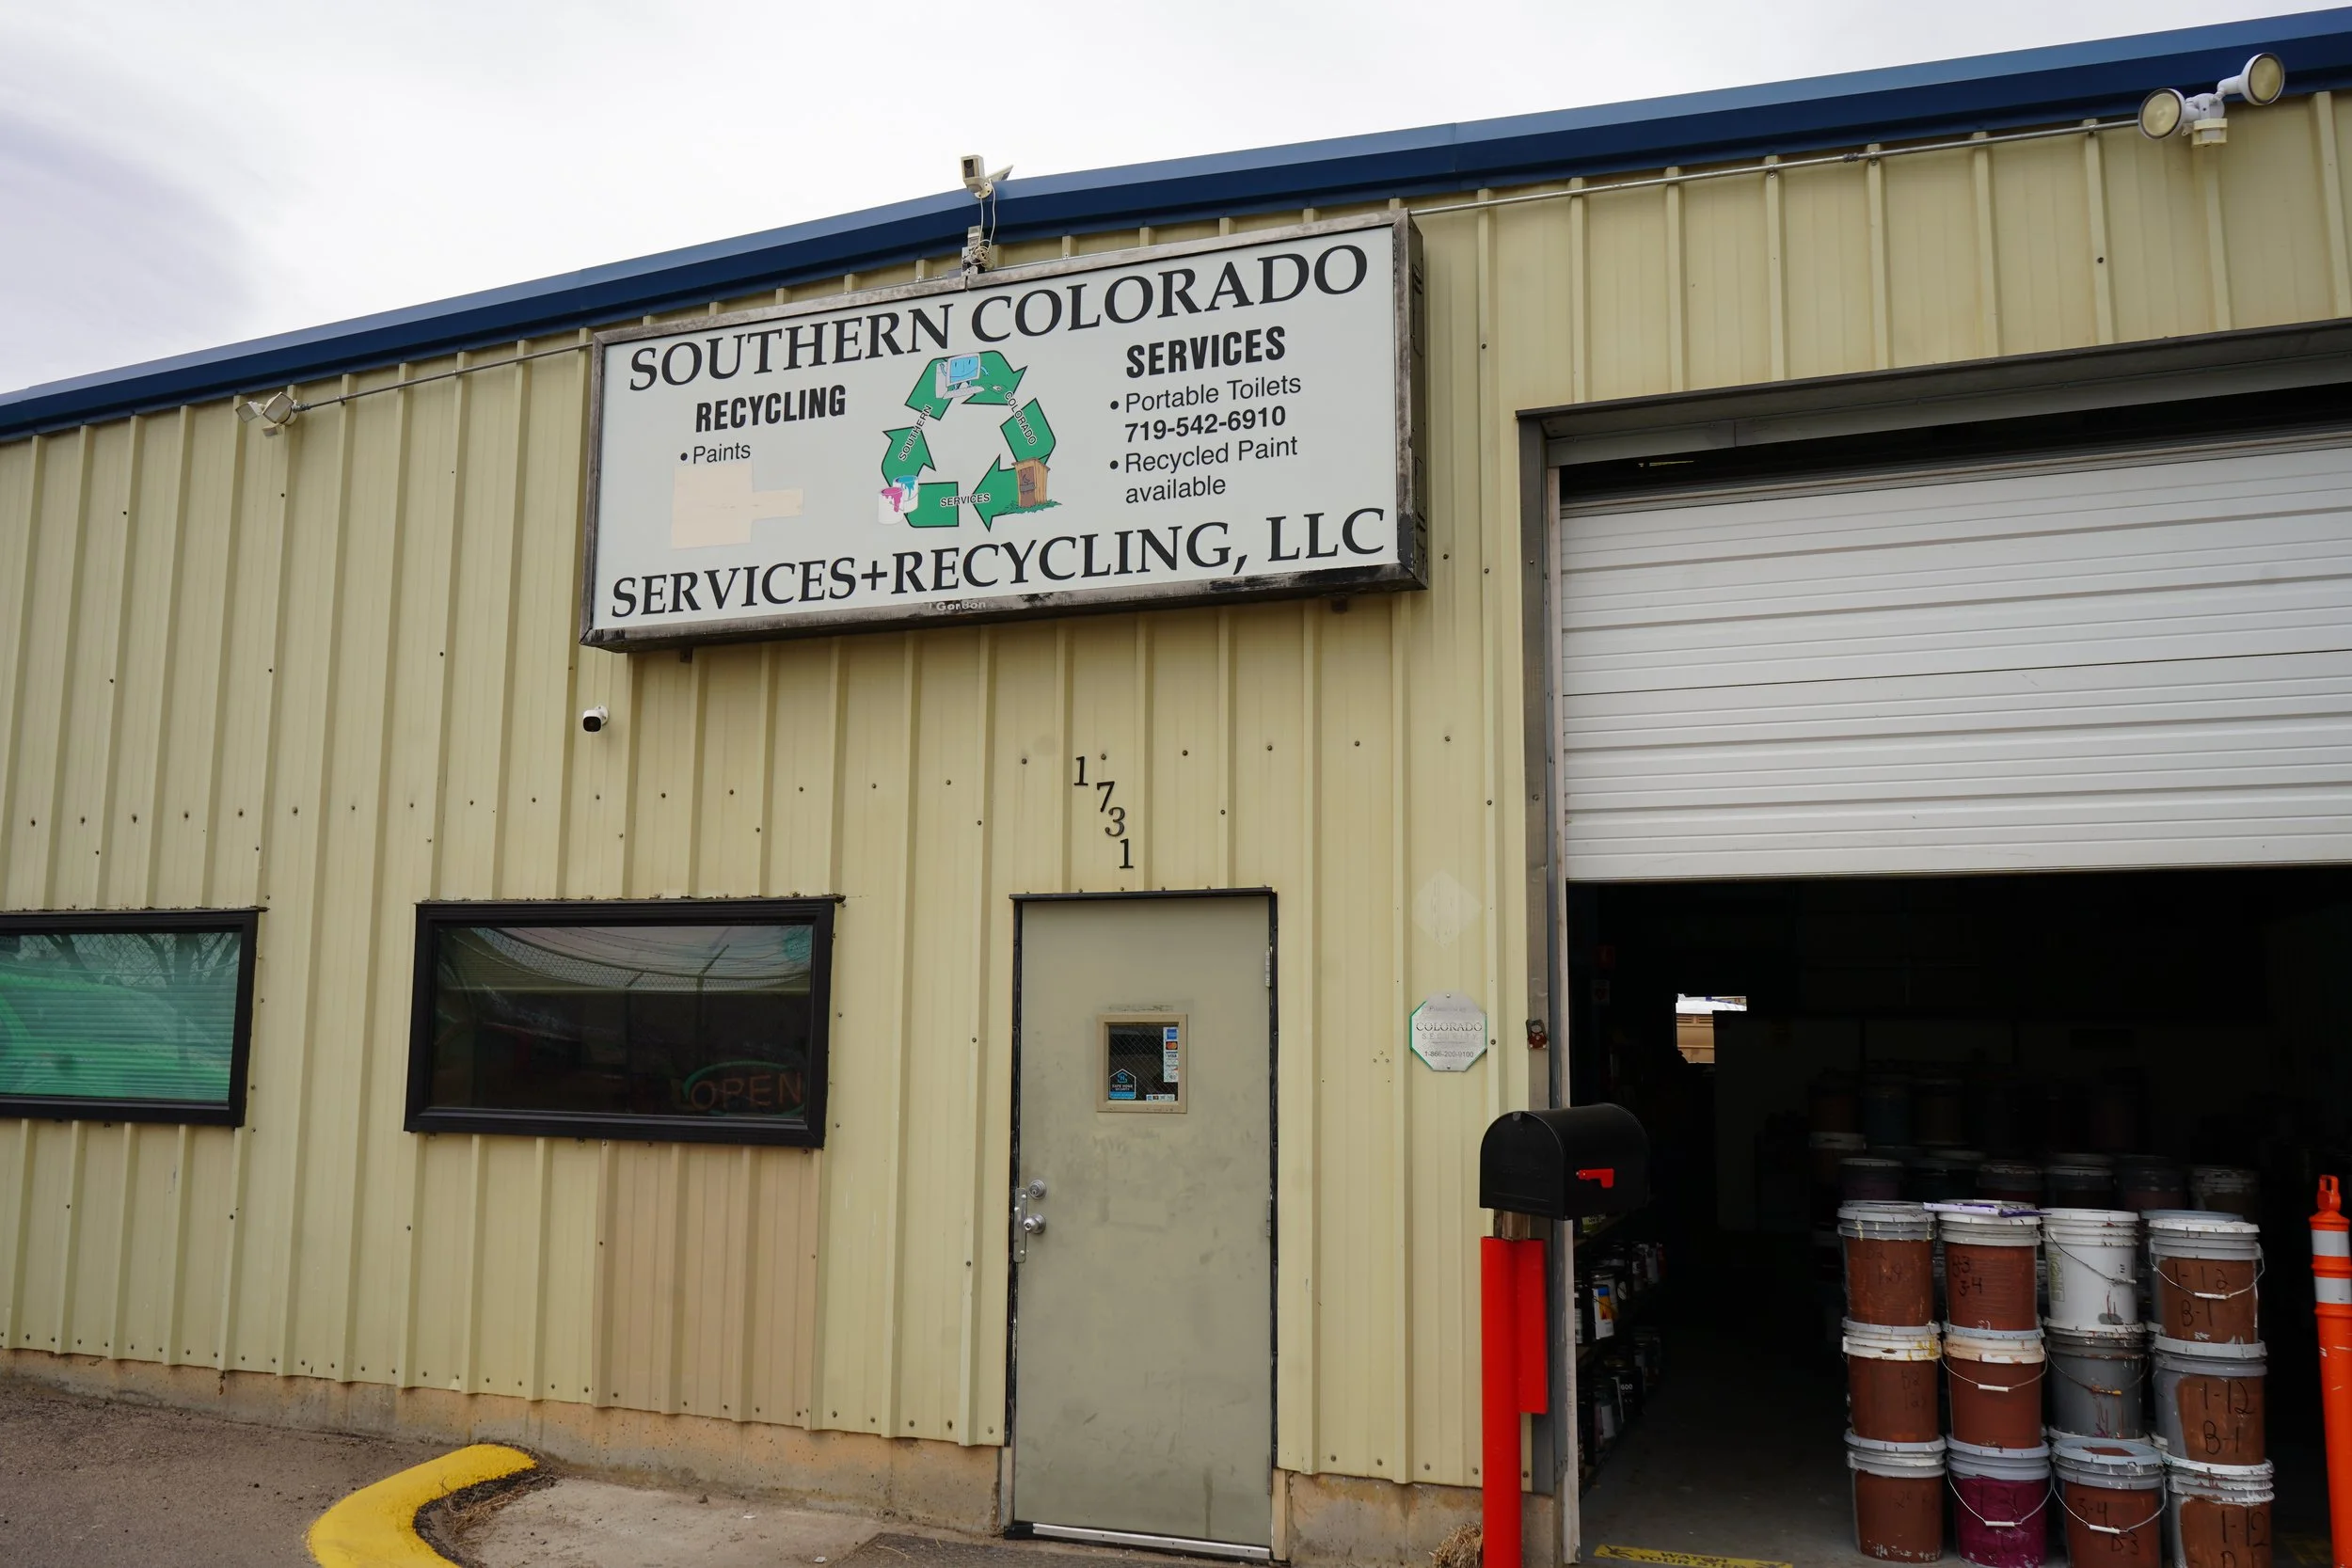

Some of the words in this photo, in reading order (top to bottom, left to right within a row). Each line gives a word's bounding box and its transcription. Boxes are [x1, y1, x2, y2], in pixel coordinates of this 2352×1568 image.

[629, 303, 954, 391] SOUTHERN
[972, 245, 1367, 342] COLORADO
[1125, 325, 1285, 378] SERVICES
[695, 384, 846, 433] RECYCLING
[1125, 384, 1219, 413] Portable
[1226, 374, 1301, 401] Toilets
[898, 404, 932, 461] SOUTHERN
[1004, 391, 1037, 446] COLORADO
[1124, 404, 1286, 444] 719-542-6910
[693, 441, 751, 464] Paints
[1125, 441, 1229, 474] Recycled
[1238, 436, 1298, 459] Paint
[940, 492, 990, 507] SERVICES
[1125, 474, 1226, 504] available
[1266, 507, 1384, 563] LLC
[1416, 1022, 1483, 1032] COLORADO
[690, 1071, 803, 1112] OPEN
[2203, 1420, 2240, 1455] B-1
